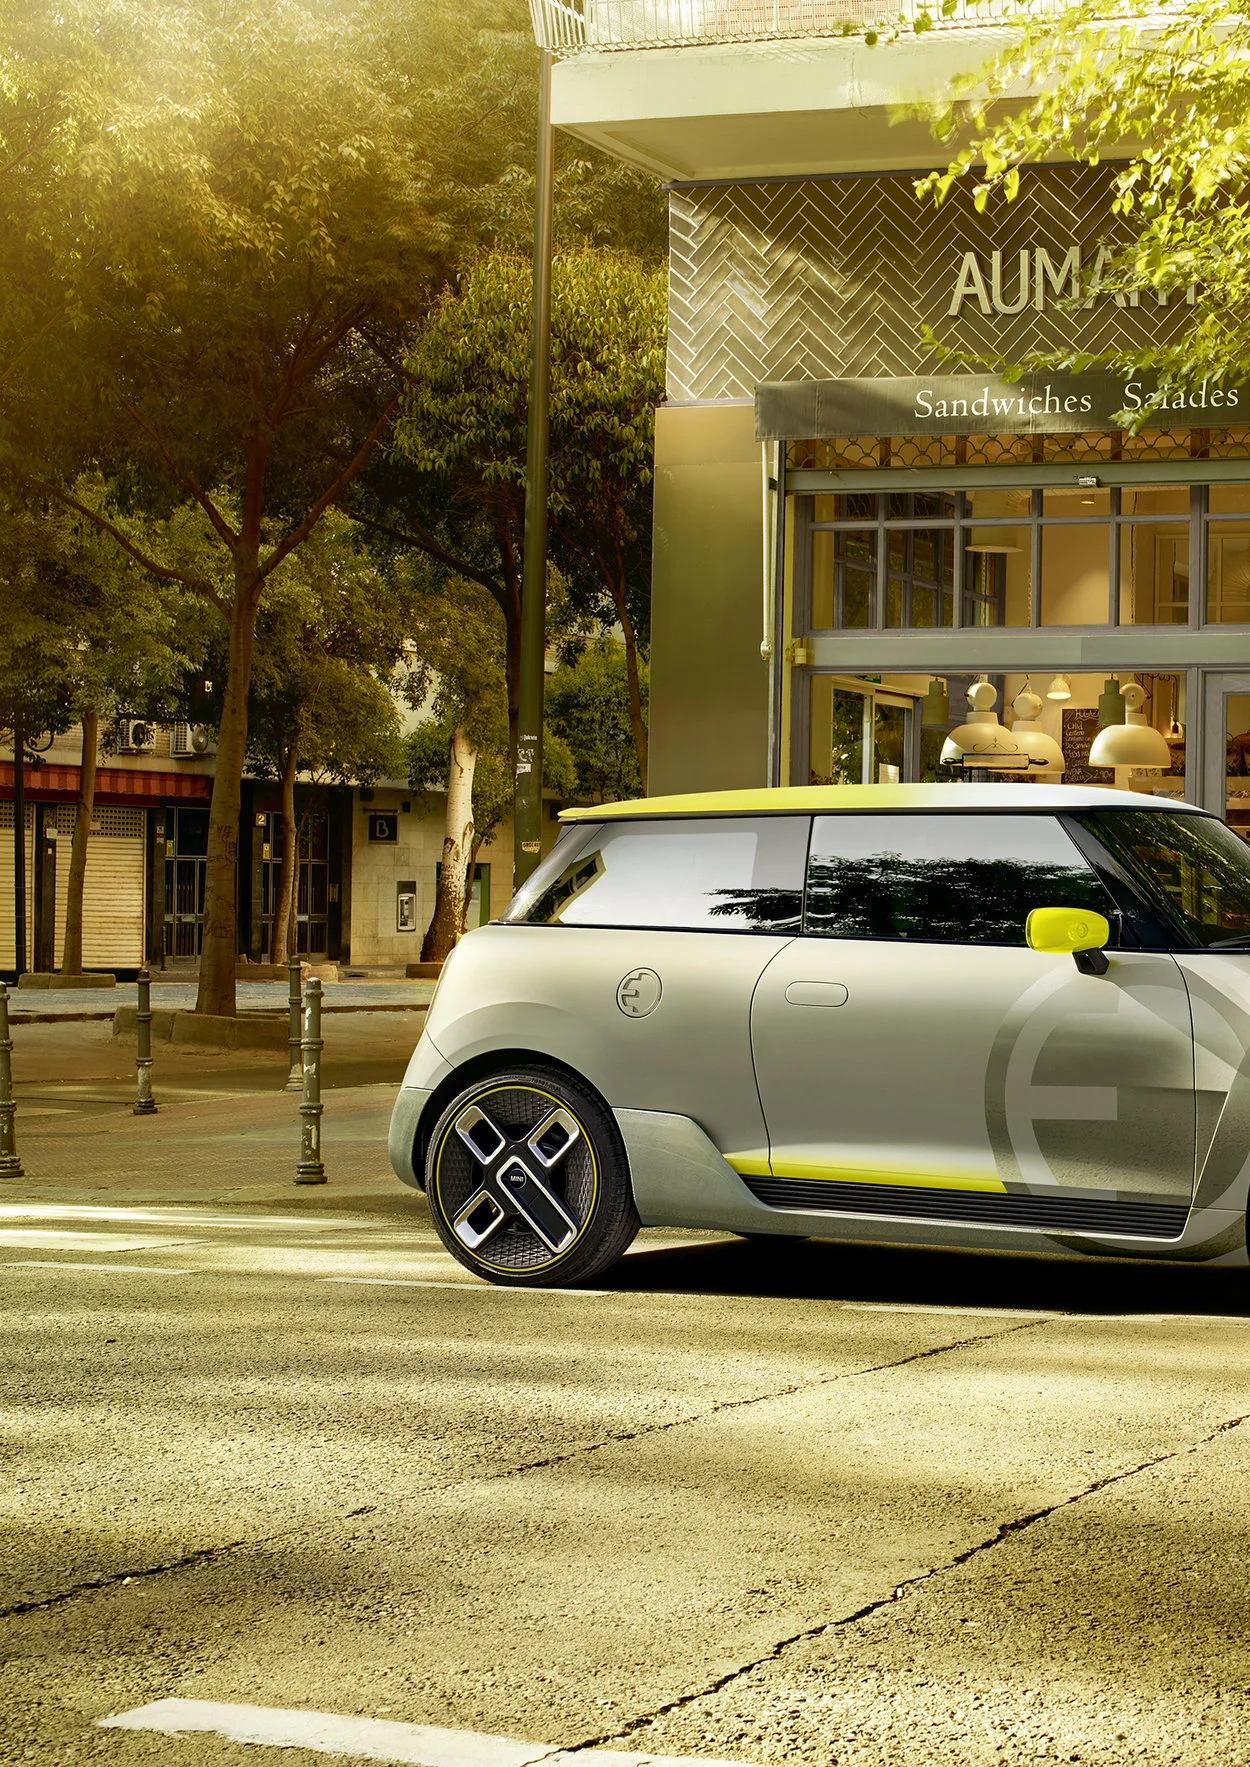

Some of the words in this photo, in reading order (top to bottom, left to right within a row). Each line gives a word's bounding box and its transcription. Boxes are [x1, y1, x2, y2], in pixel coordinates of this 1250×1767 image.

[914, 385, 1092, 418] Sandwiches
[1122, 379, 1239, 411] Salades
[258, 815, 265, 825] 2
